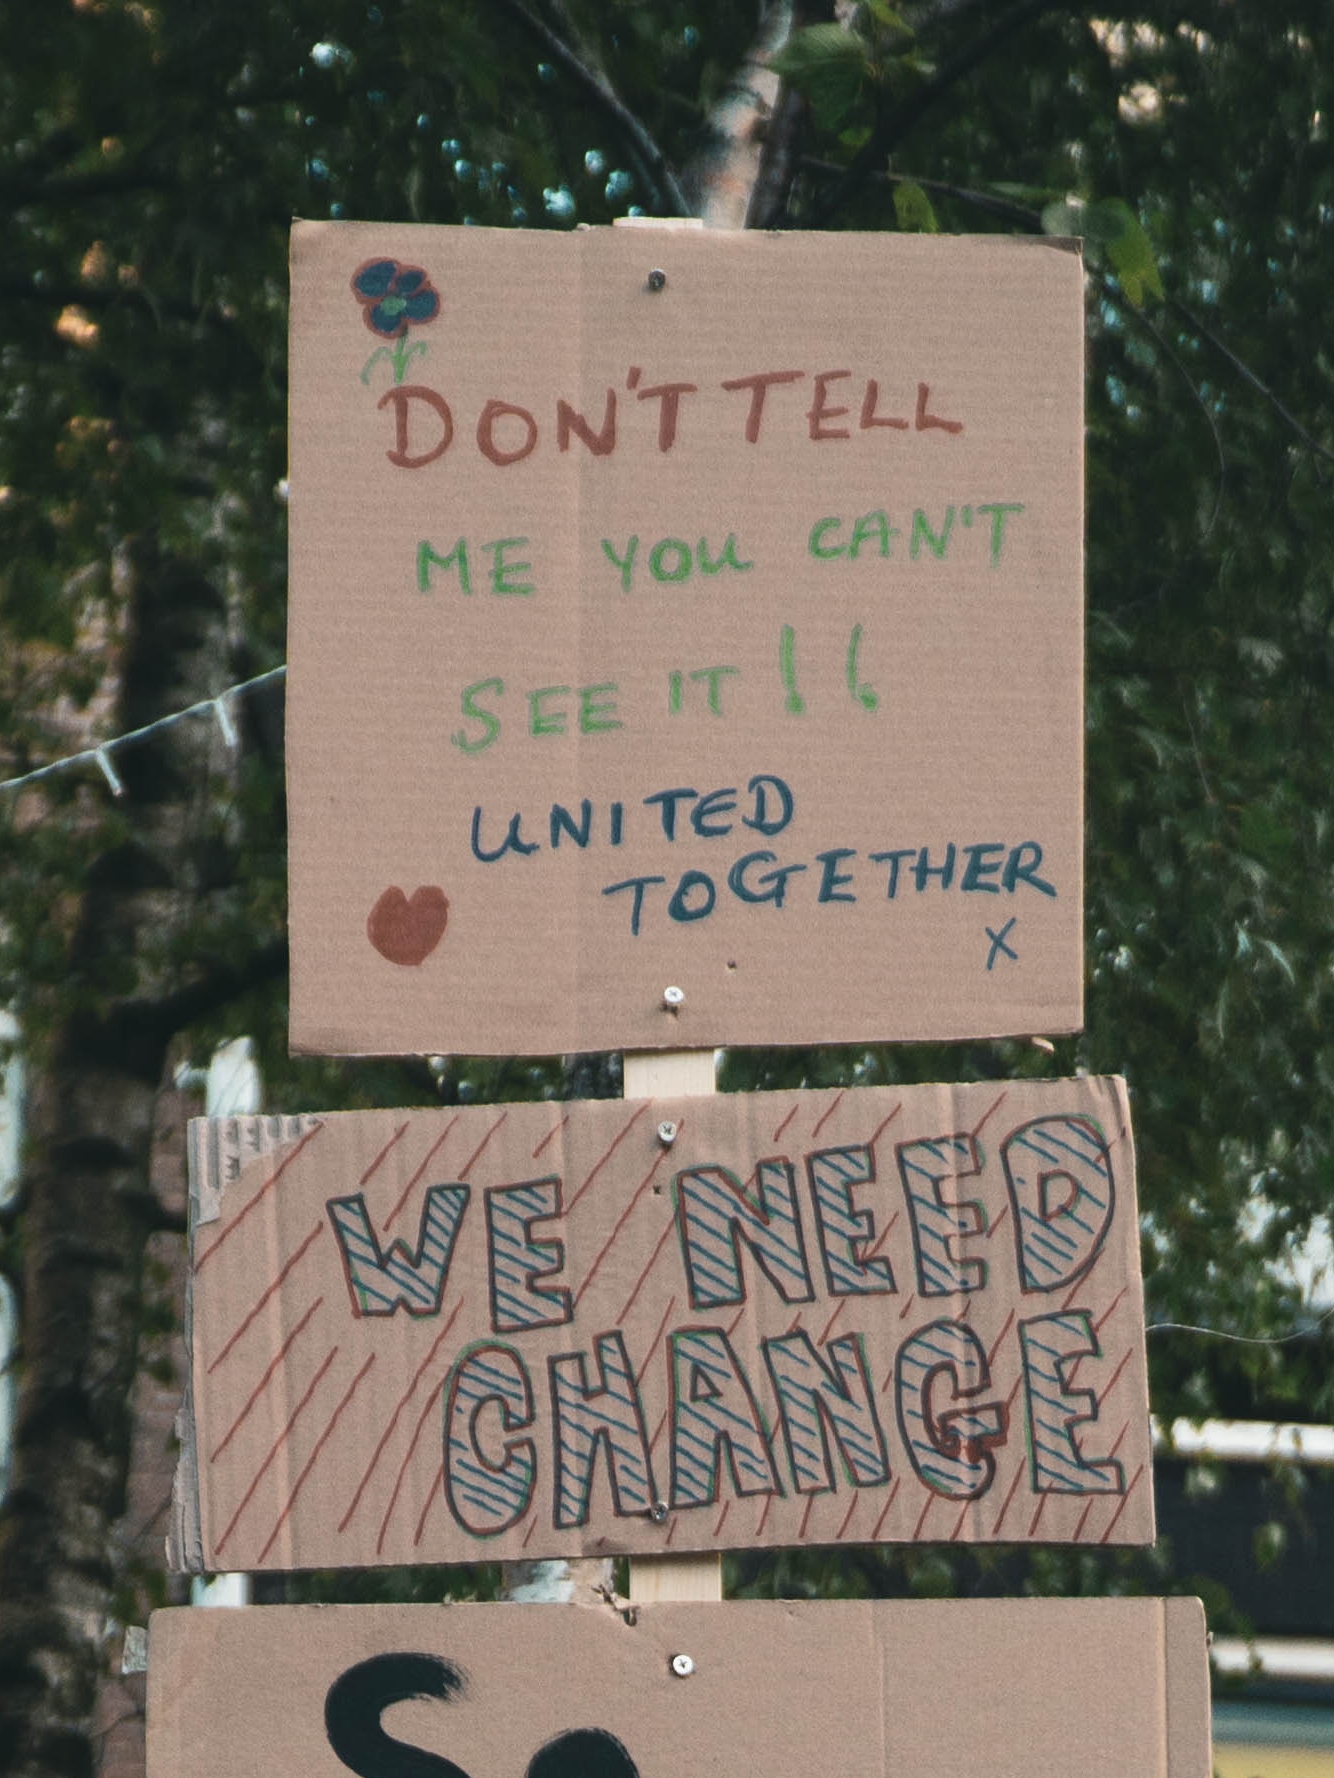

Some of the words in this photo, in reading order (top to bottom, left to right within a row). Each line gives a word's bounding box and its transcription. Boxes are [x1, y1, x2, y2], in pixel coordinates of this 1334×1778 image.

[377, 366, 697, 468] DON'T
[720, 369, 965, 444] TELL
[416, 536, 535, 597] ME
[808, 502, 1025, 568] CAN'T
[450, 676, 623, 754] SEE
[469, 774, 795, 863] UNITED
[601, 840, 1056, 936] TOGETHER
[326, 1178, 574, 1333] WE
[675, 1113, 1116, 1311] NEED
[443, 1307, 1125, 1540] CHANGE
